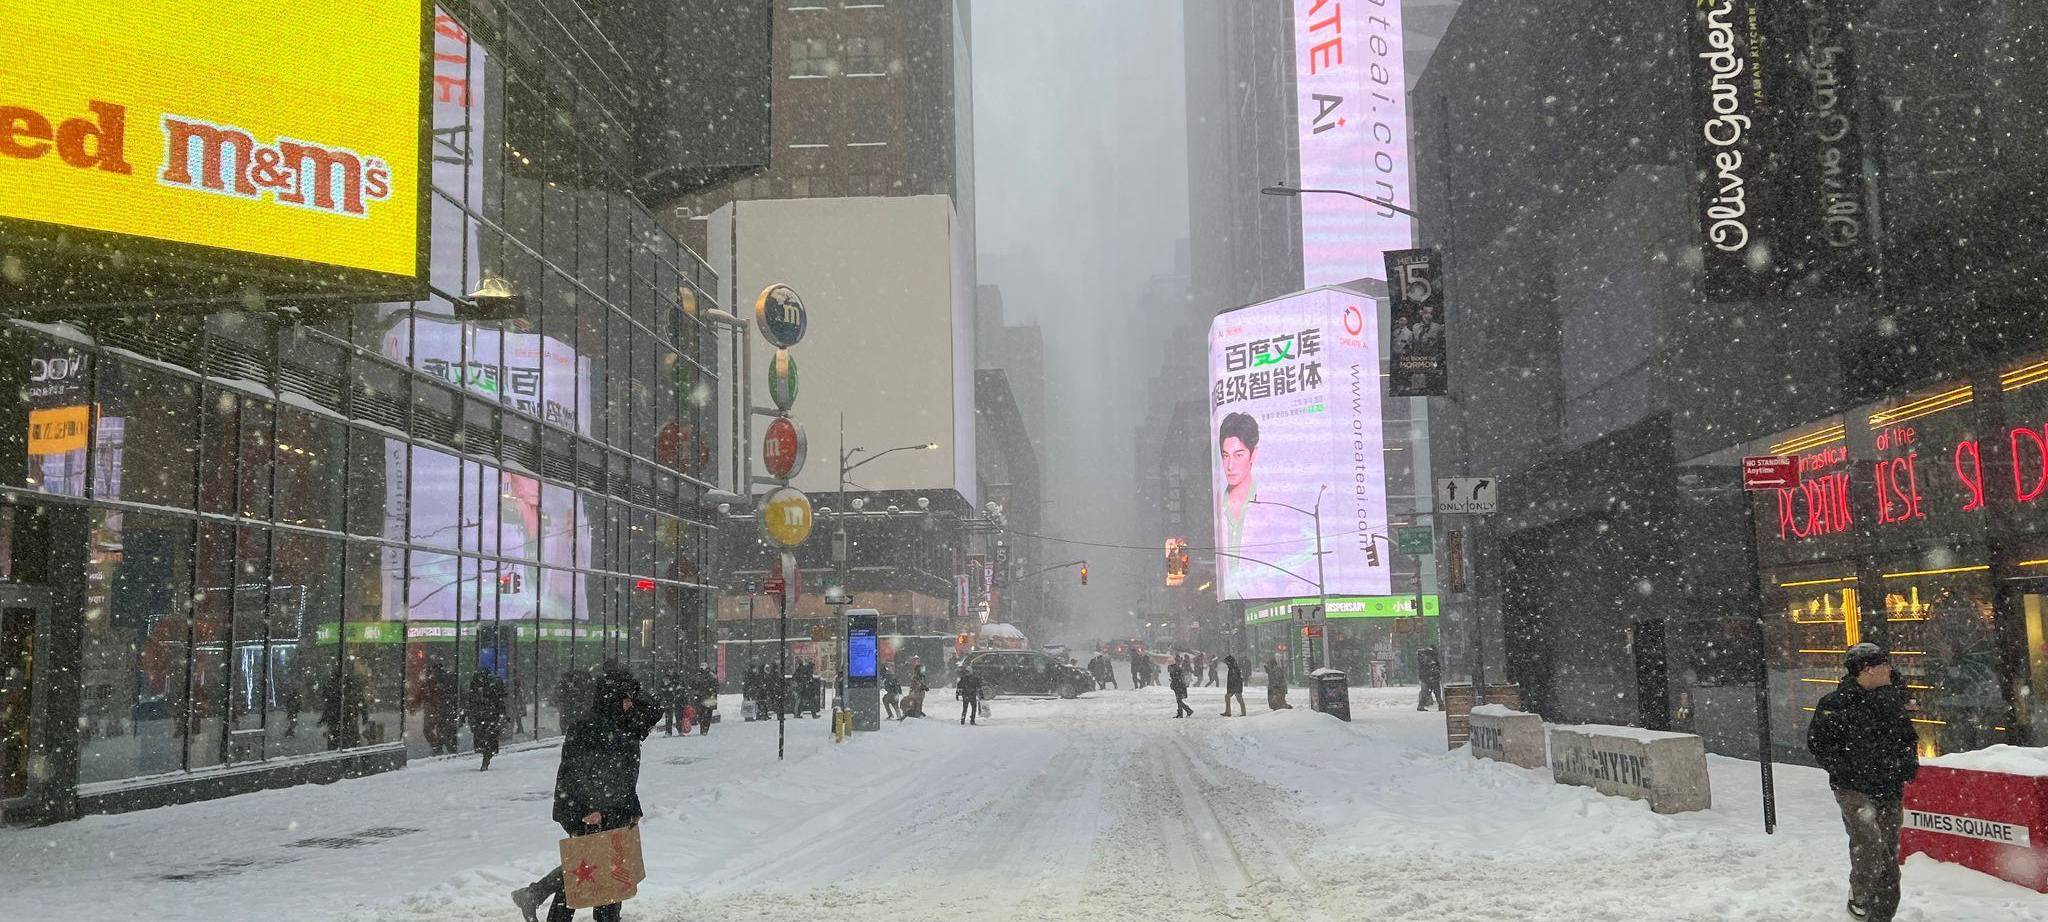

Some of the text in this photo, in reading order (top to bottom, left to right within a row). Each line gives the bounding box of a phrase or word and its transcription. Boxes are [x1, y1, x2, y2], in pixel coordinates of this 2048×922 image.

[1700, 1, 1751, 251] Olive Garden
[1397, 255, 1430, 265] HELLO
[1394, 264, 1432, 302] 15
[783, 302, 800, 326] m
[1225, 328, 1321, 373] 百度文库
[1213, 361, 1322, 407] 超级智能体
[765, 436, 780, 457] m
[1876, 428, 1890, 450] of
[1747, 467, 1775, 475] Anytime
[1757, 458, 1791, 466] STANDING
[783, 506, 804, 526] m
[1440, 502, 1495, 511] ONLY ONLY
[1598, 751, 1641, 786] NYPD
[1911, 812, 2013, 841] TIMES SQUARE
